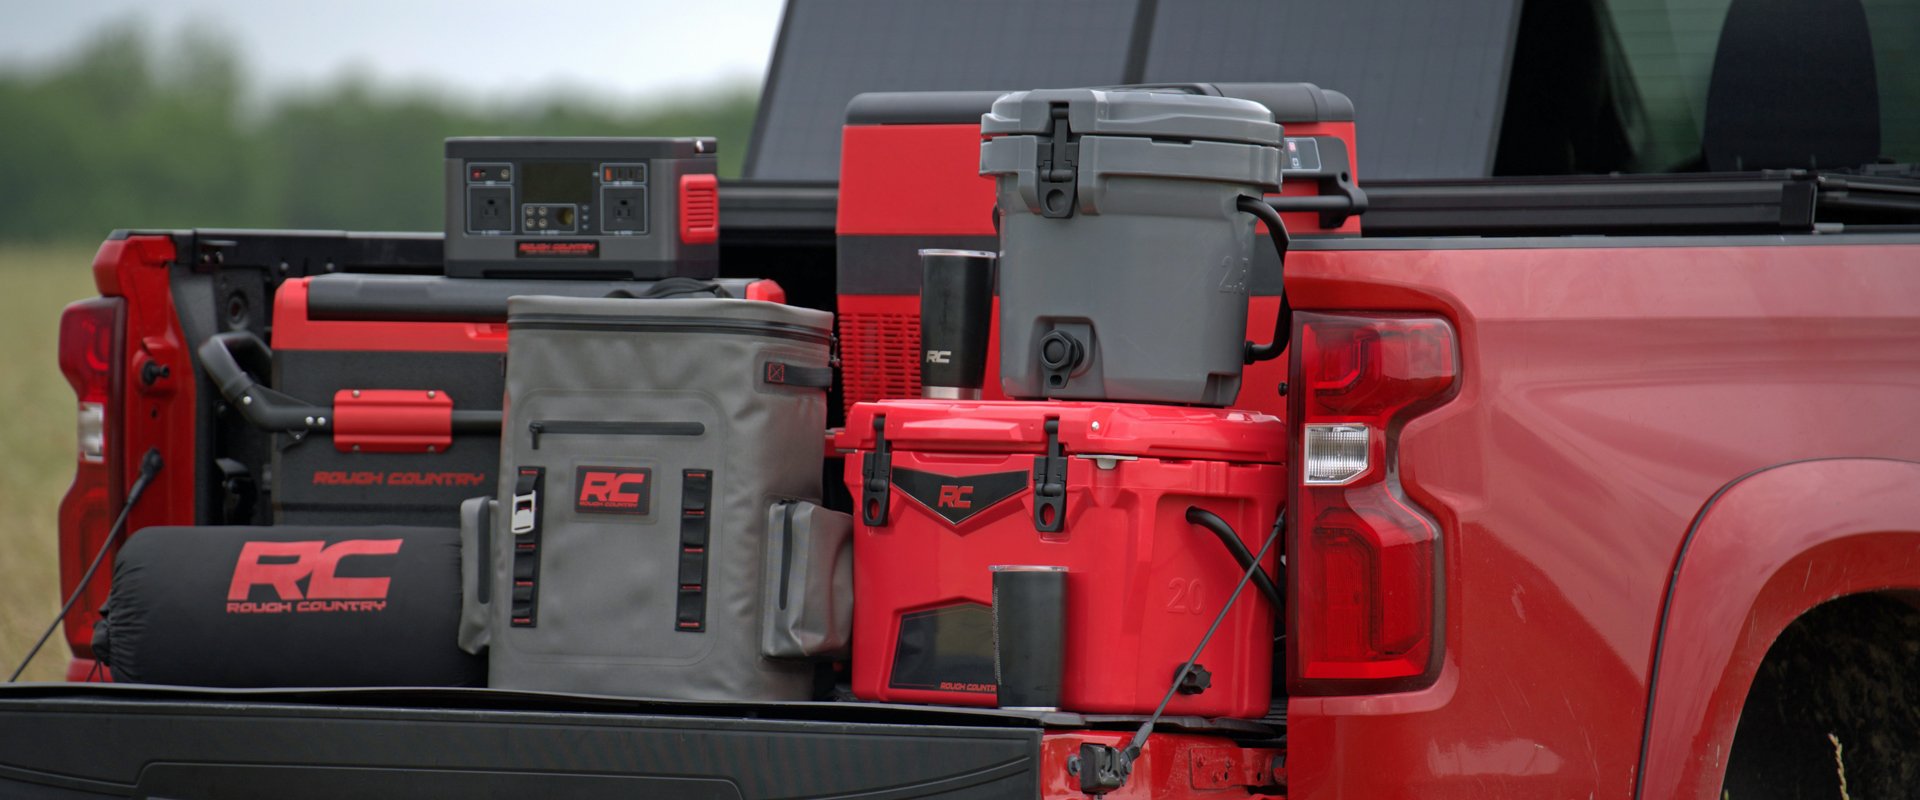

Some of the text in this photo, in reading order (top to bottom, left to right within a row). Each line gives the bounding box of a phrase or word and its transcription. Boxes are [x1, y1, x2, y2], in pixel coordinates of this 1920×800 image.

[926, 350, 952, 364] RC
[313, 471, 485, 487] ROUGH COUNTRY
[579, 471, 645, 502] RC
[938, 484, 974, 508] RC
[227, 538, 404, 601] RC
[1167, 576, 1207, 616] 20
[226, 600, 387, 614] ROUGH COUNTRY
[940, 682, 997, 692] ROUGH COUNTR
